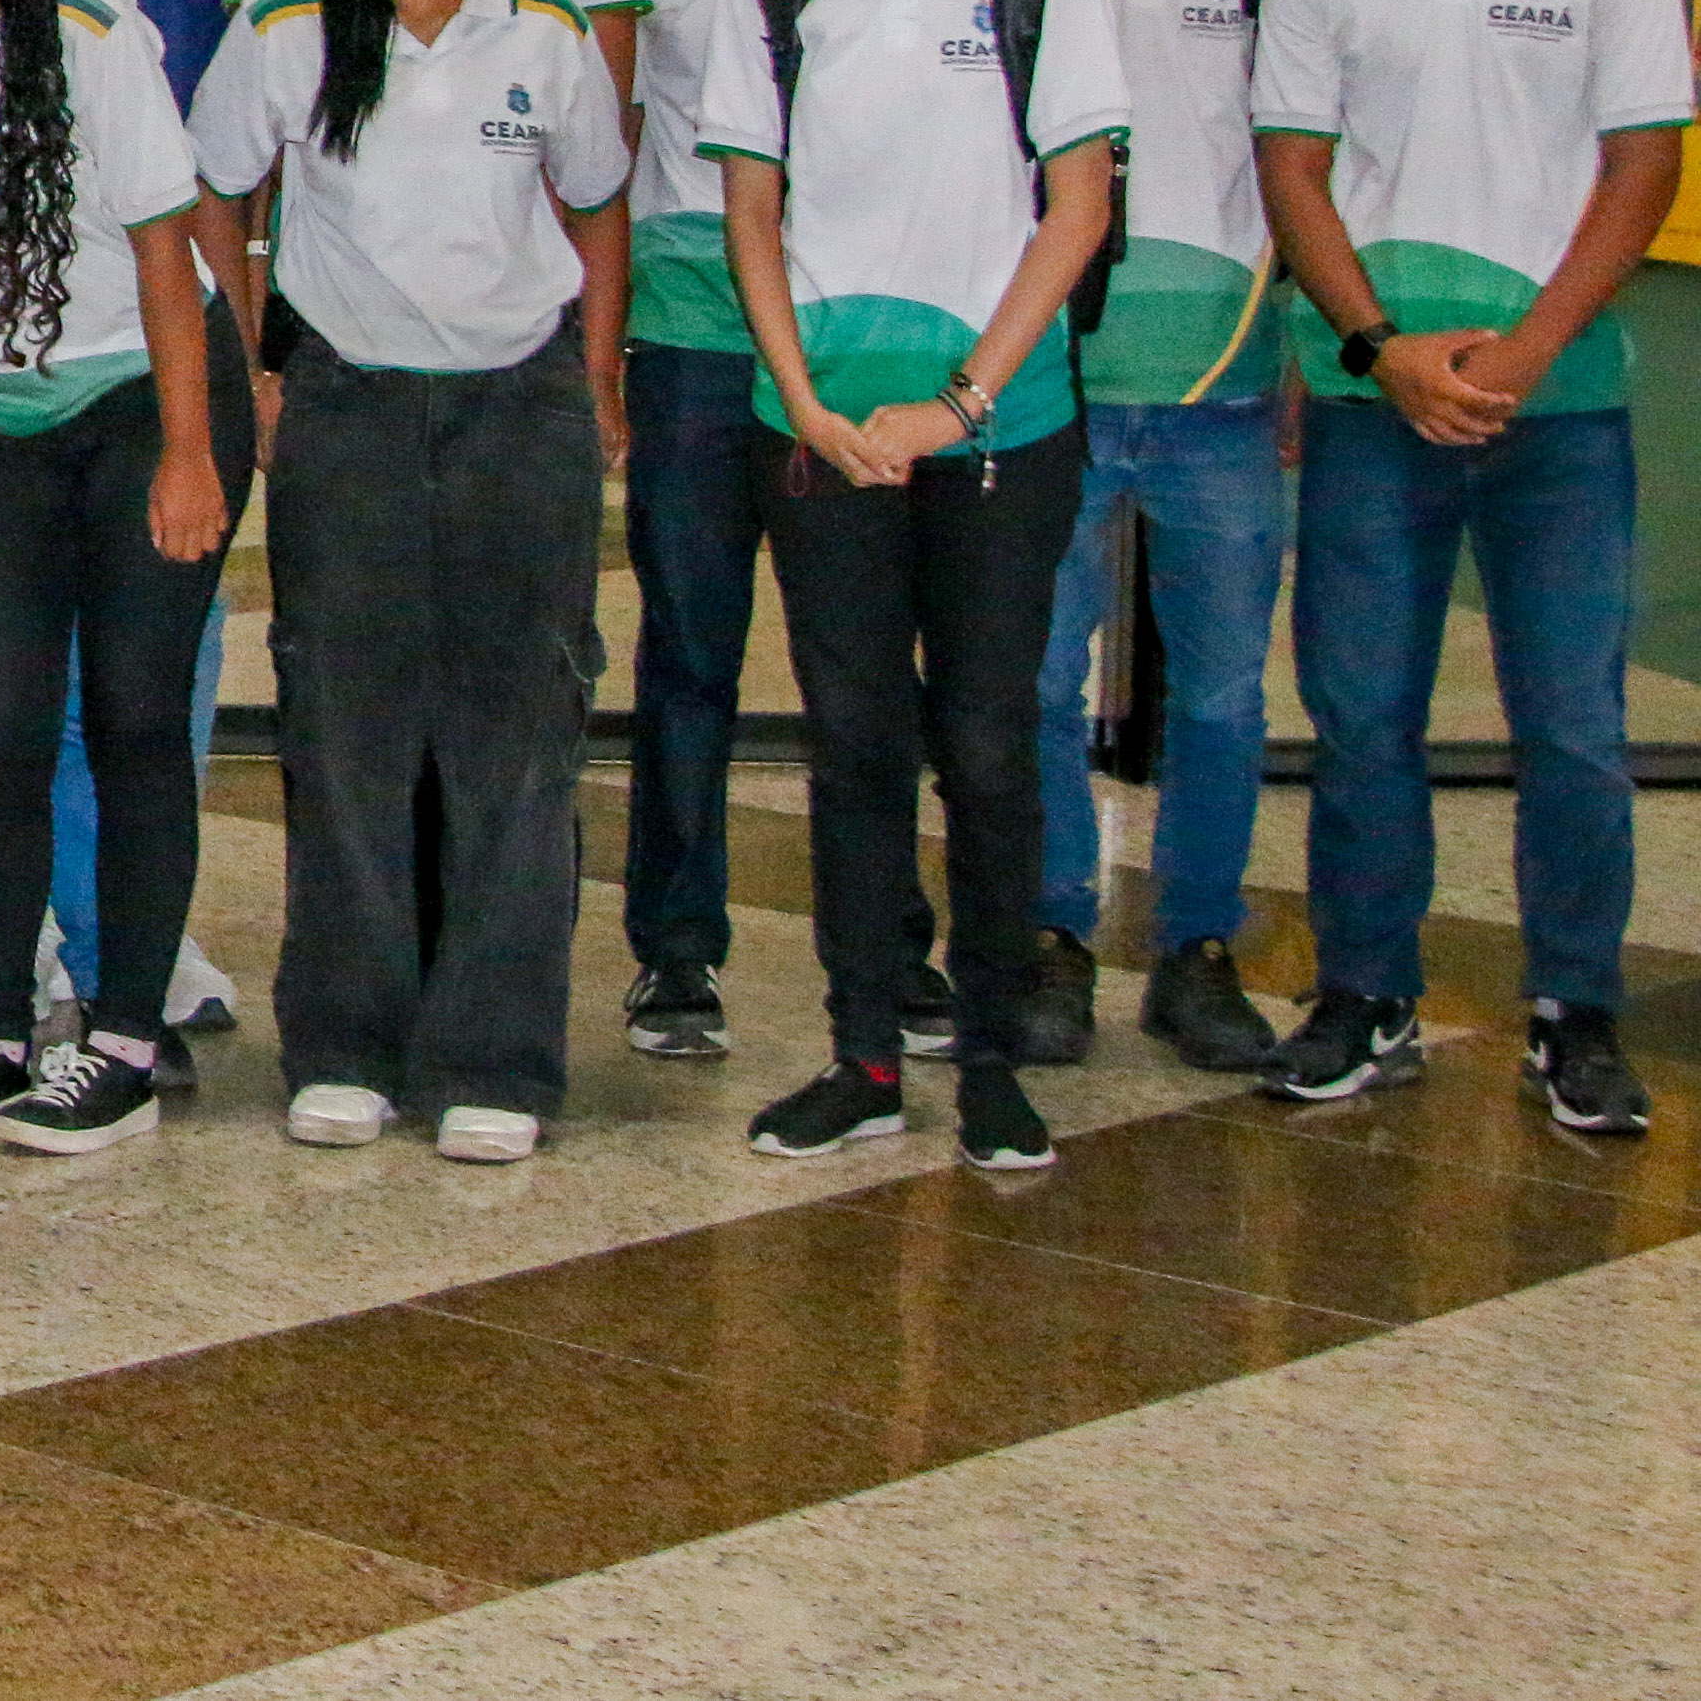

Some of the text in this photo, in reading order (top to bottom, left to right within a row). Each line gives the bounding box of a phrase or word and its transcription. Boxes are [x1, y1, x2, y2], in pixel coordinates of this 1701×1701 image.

[1182, 7, 1242, 25] CEAR
[1488, 5, 1573, 29] CEARÁ
[940, 39, 994, 56] CEA
[480, 121, 545, 140] CEAR
